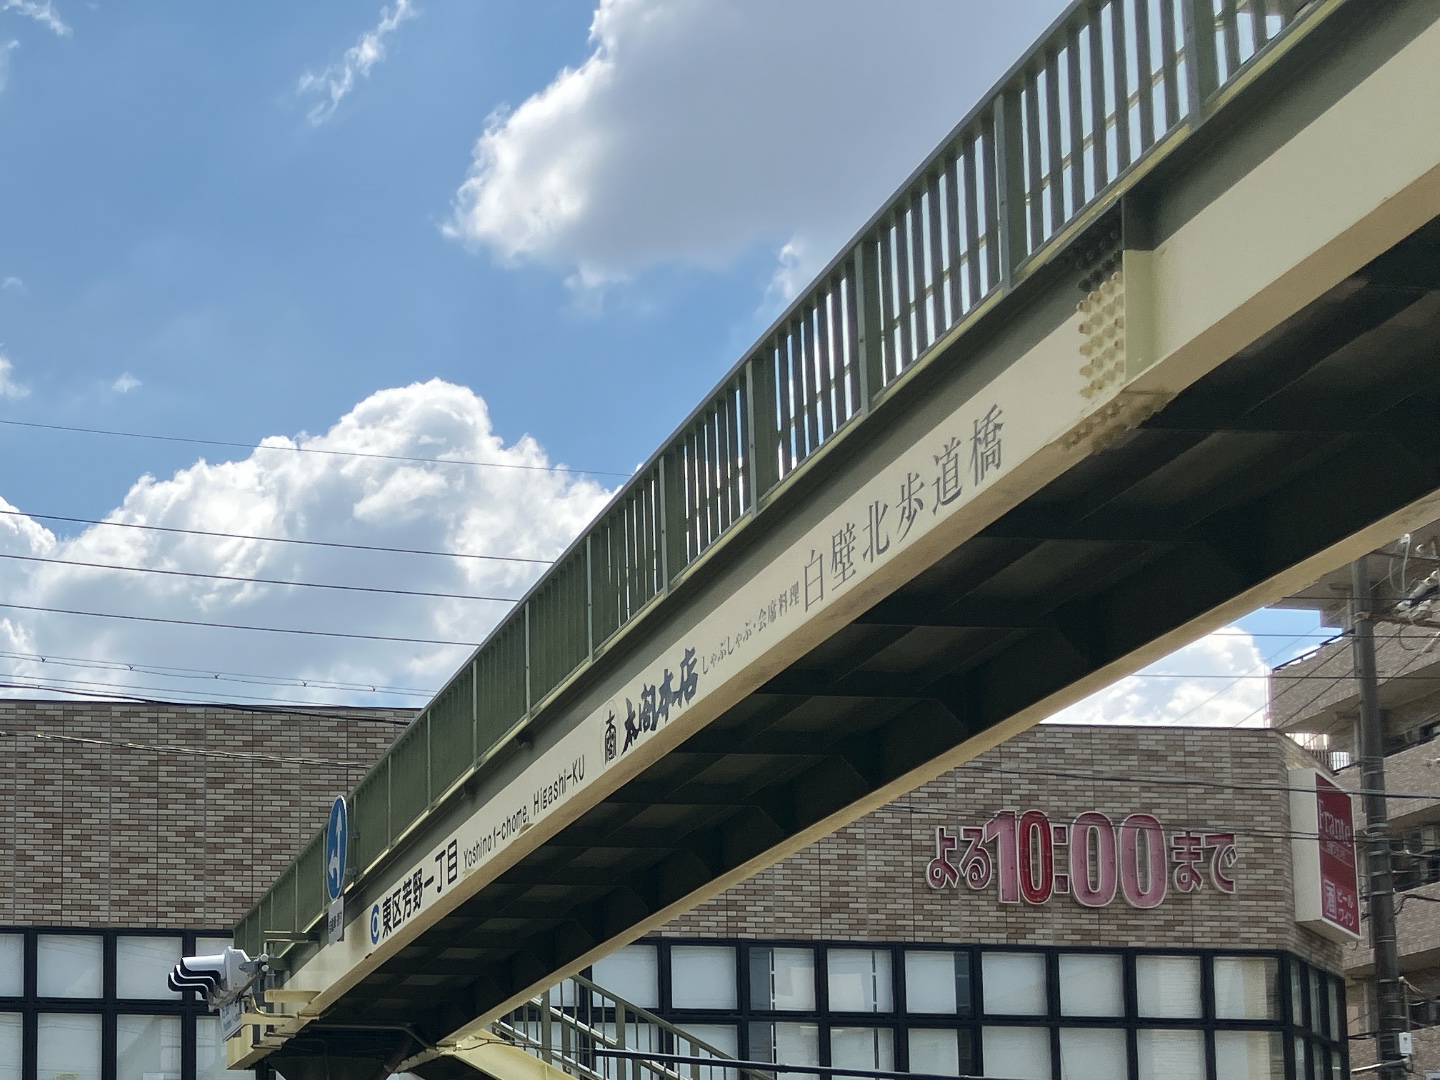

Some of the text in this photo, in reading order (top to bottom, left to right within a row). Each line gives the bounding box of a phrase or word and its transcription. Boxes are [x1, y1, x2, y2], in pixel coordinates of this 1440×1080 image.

[803, 403, 1006, 613] 白壁北歩道橋
[533, 754, 585, 817] Higashi-KU
[381, 838, 458, 939] 東区芳野一丁目
